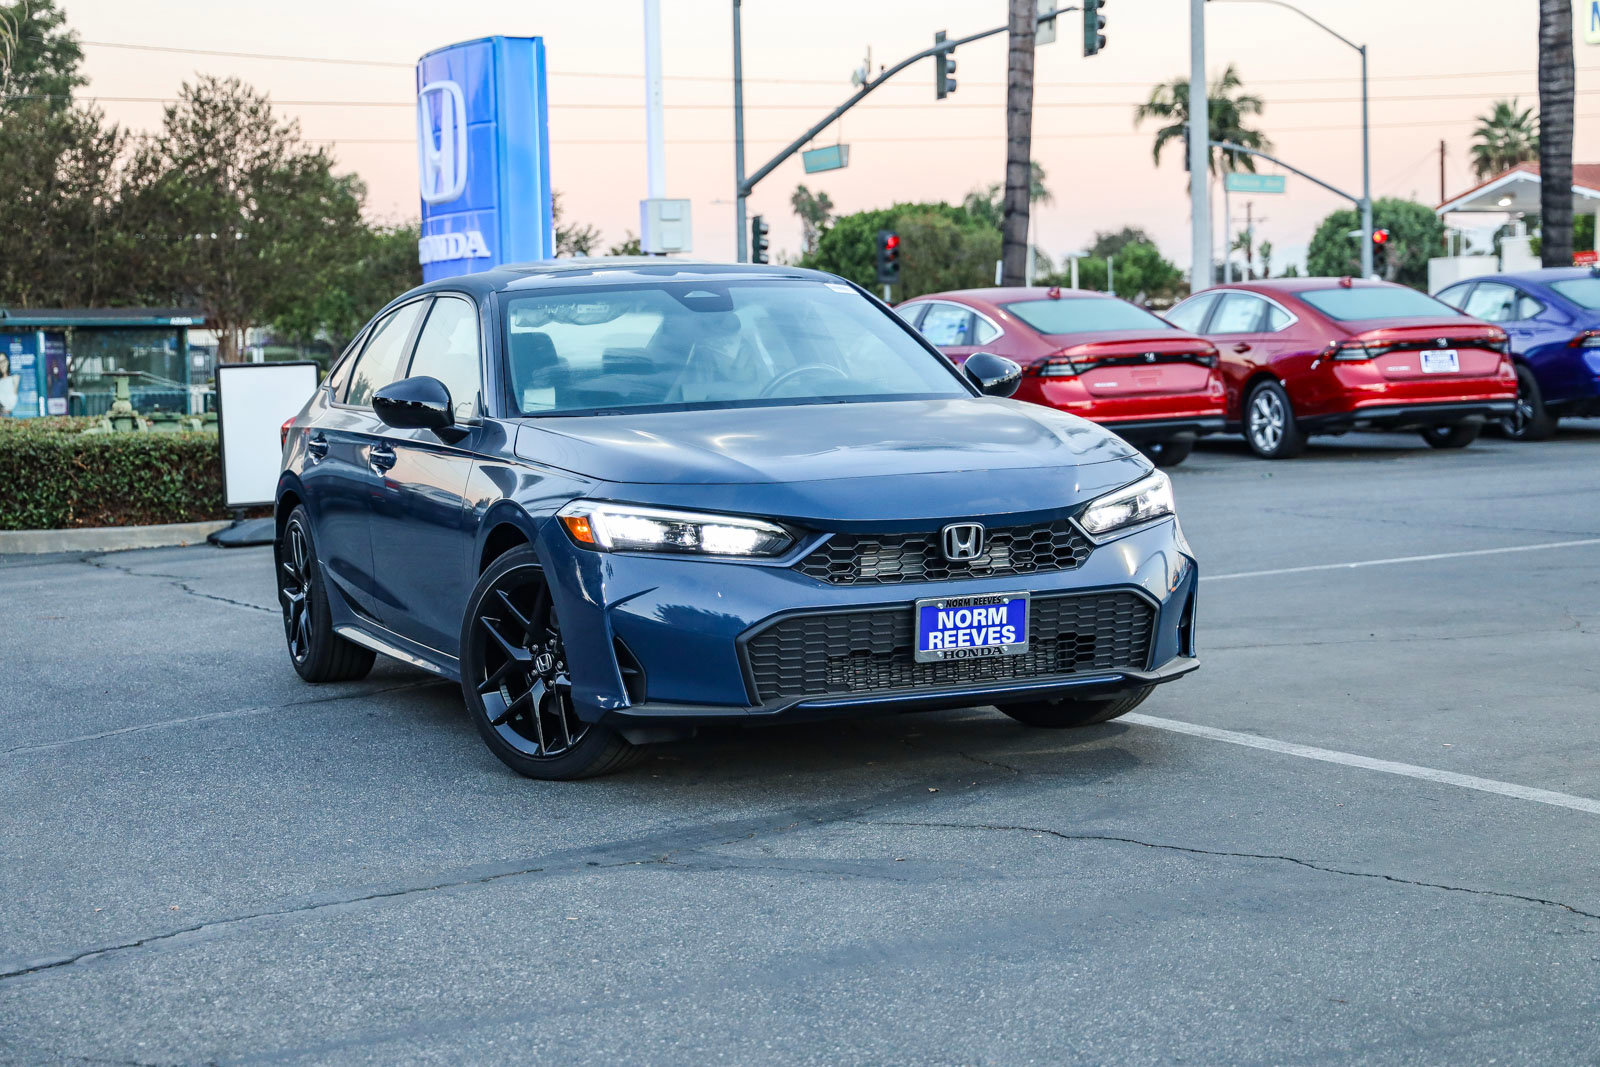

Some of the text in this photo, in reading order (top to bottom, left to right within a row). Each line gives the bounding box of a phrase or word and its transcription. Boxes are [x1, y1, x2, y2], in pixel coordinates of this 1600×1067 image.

[418, 231, 491, 265] NDA
[946, 596, 1001, 608] NORM REEVES
[937, 606, 1007, 630] NORM
[928, 625, 1016, 650] REEVES
[943, 646, 1004, 660] HONDA
